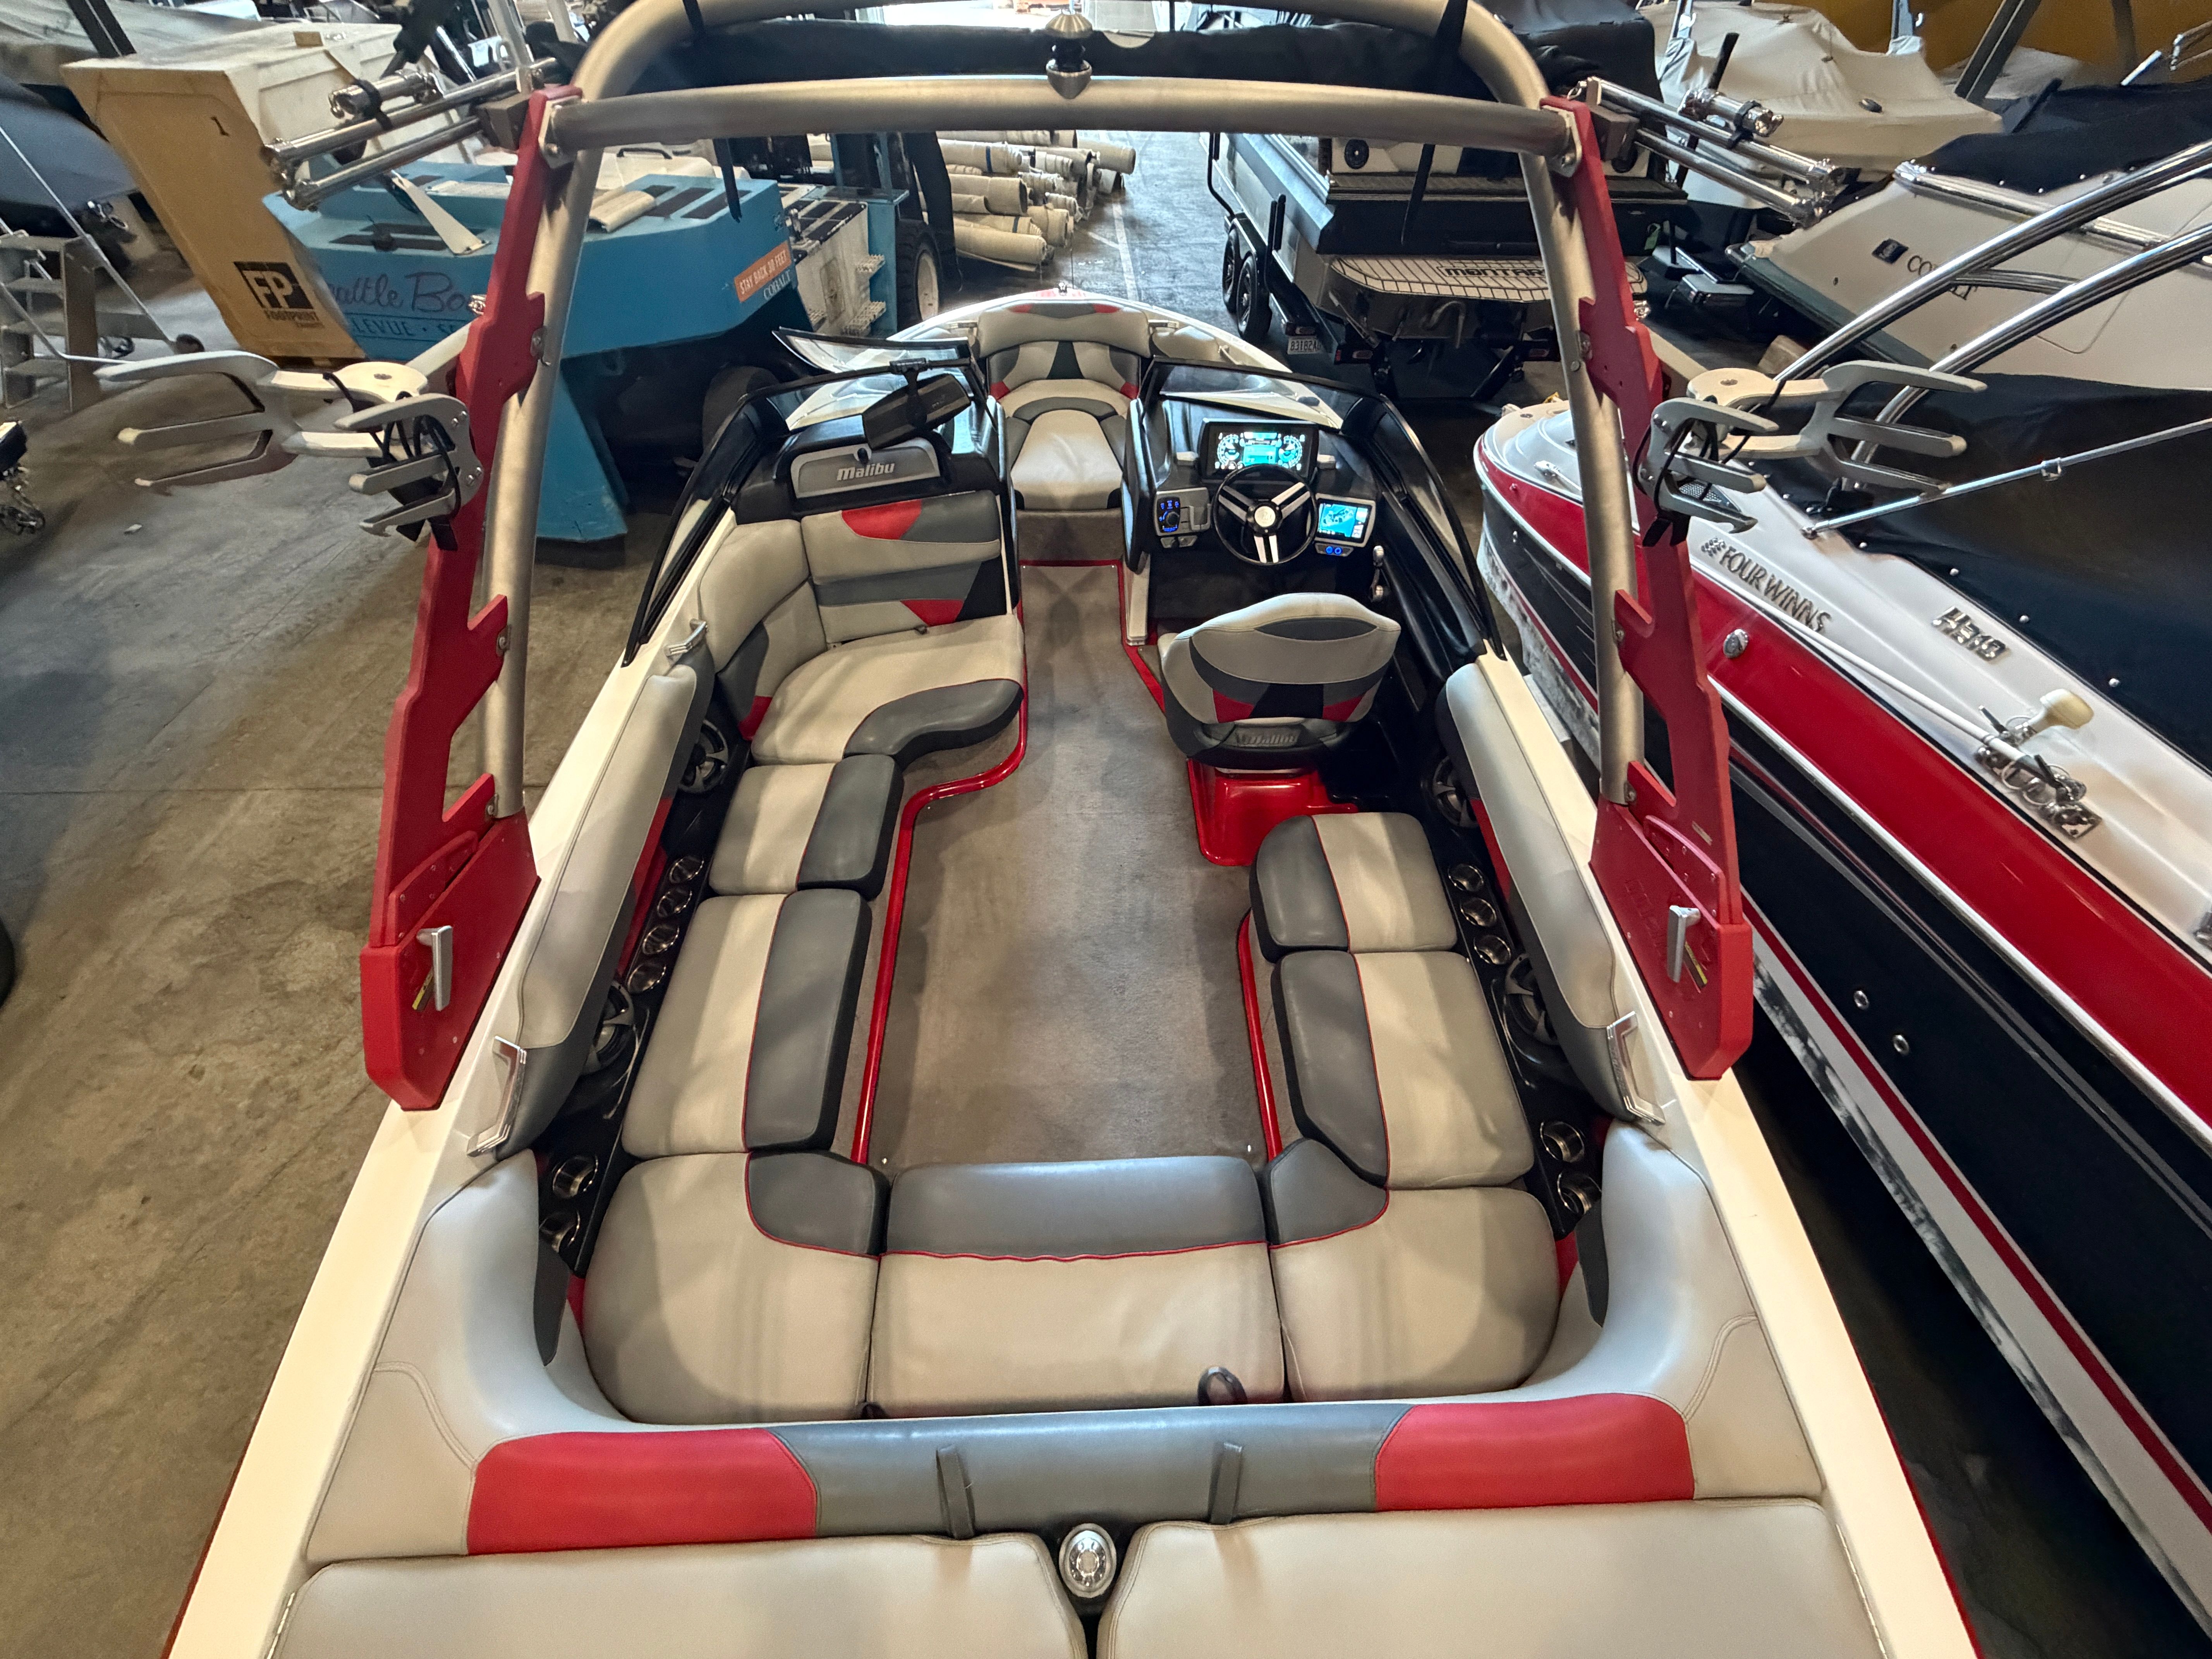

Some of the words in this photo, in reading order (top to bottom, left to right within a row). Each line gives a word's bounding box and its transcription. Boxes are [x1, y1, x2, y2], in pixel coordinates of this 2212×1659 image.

[242, 270, 293, 309] FP
[739, 274, 754, 295] STAY
[753, 264, 768, 285] BACK
[775, 249, 787, 268] FEET
[763, 269, 790, 301] COBALT
[405, 271, 471, 313] Bo
[351, 318, 416, 337] LEVUE
